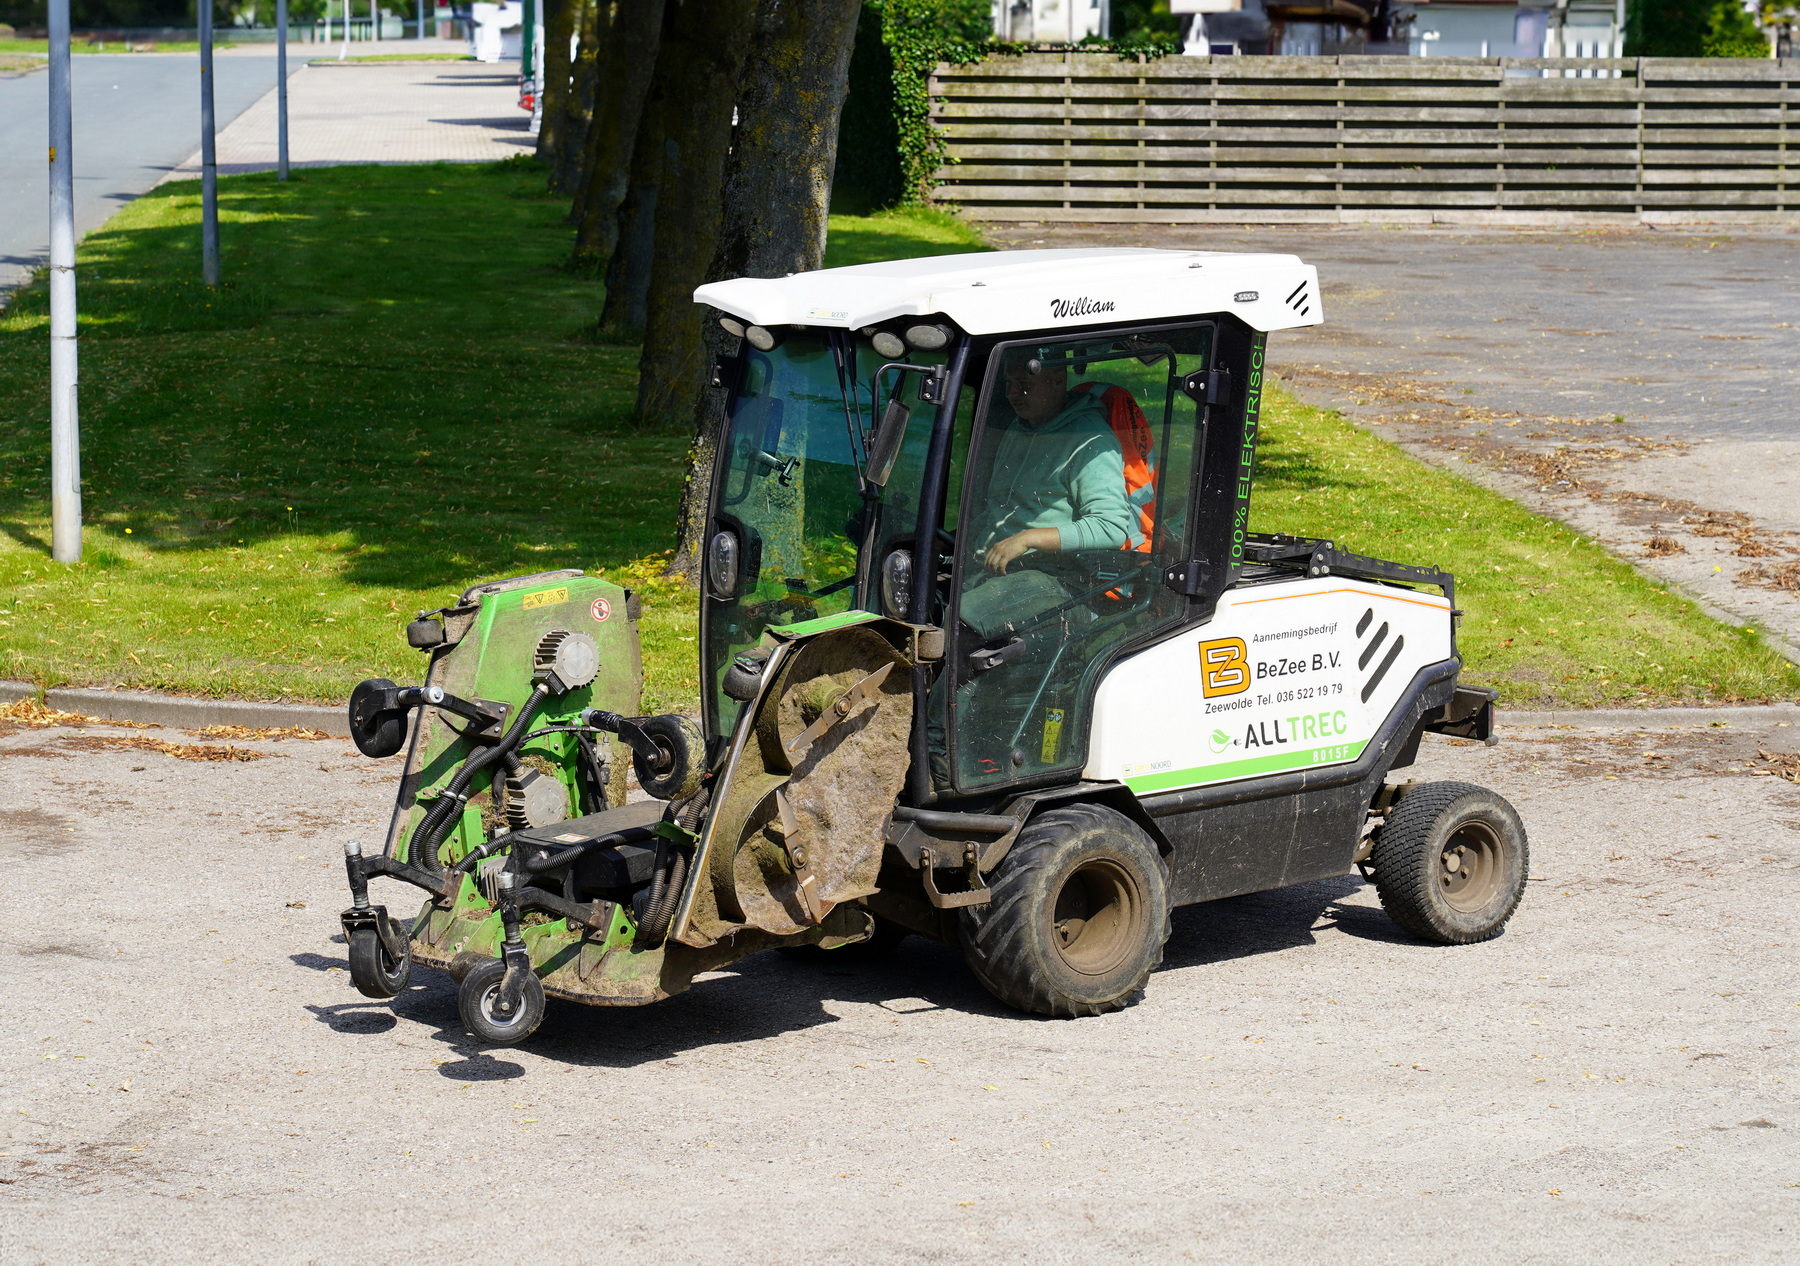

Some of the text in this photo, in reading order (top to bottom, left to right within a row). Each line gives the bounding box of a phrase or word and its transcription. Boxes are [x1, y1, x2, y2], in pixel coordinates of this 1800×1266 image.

[1050, 296, 1116, 319] William
[1230, 332, 1265, 570] 100% ELEKTRISCH
[1252, 622, 1338, 644] Aannemingsbedrijf
[1256, 650, 1342, 679] BeZee B.V.
[1204, 683, 1343, 715] Zeewolde Tel. 036 522 19 79
[1244, 710, 1347, 749] ALLTREC
[1313, 745, 1349, 763] 8015F
